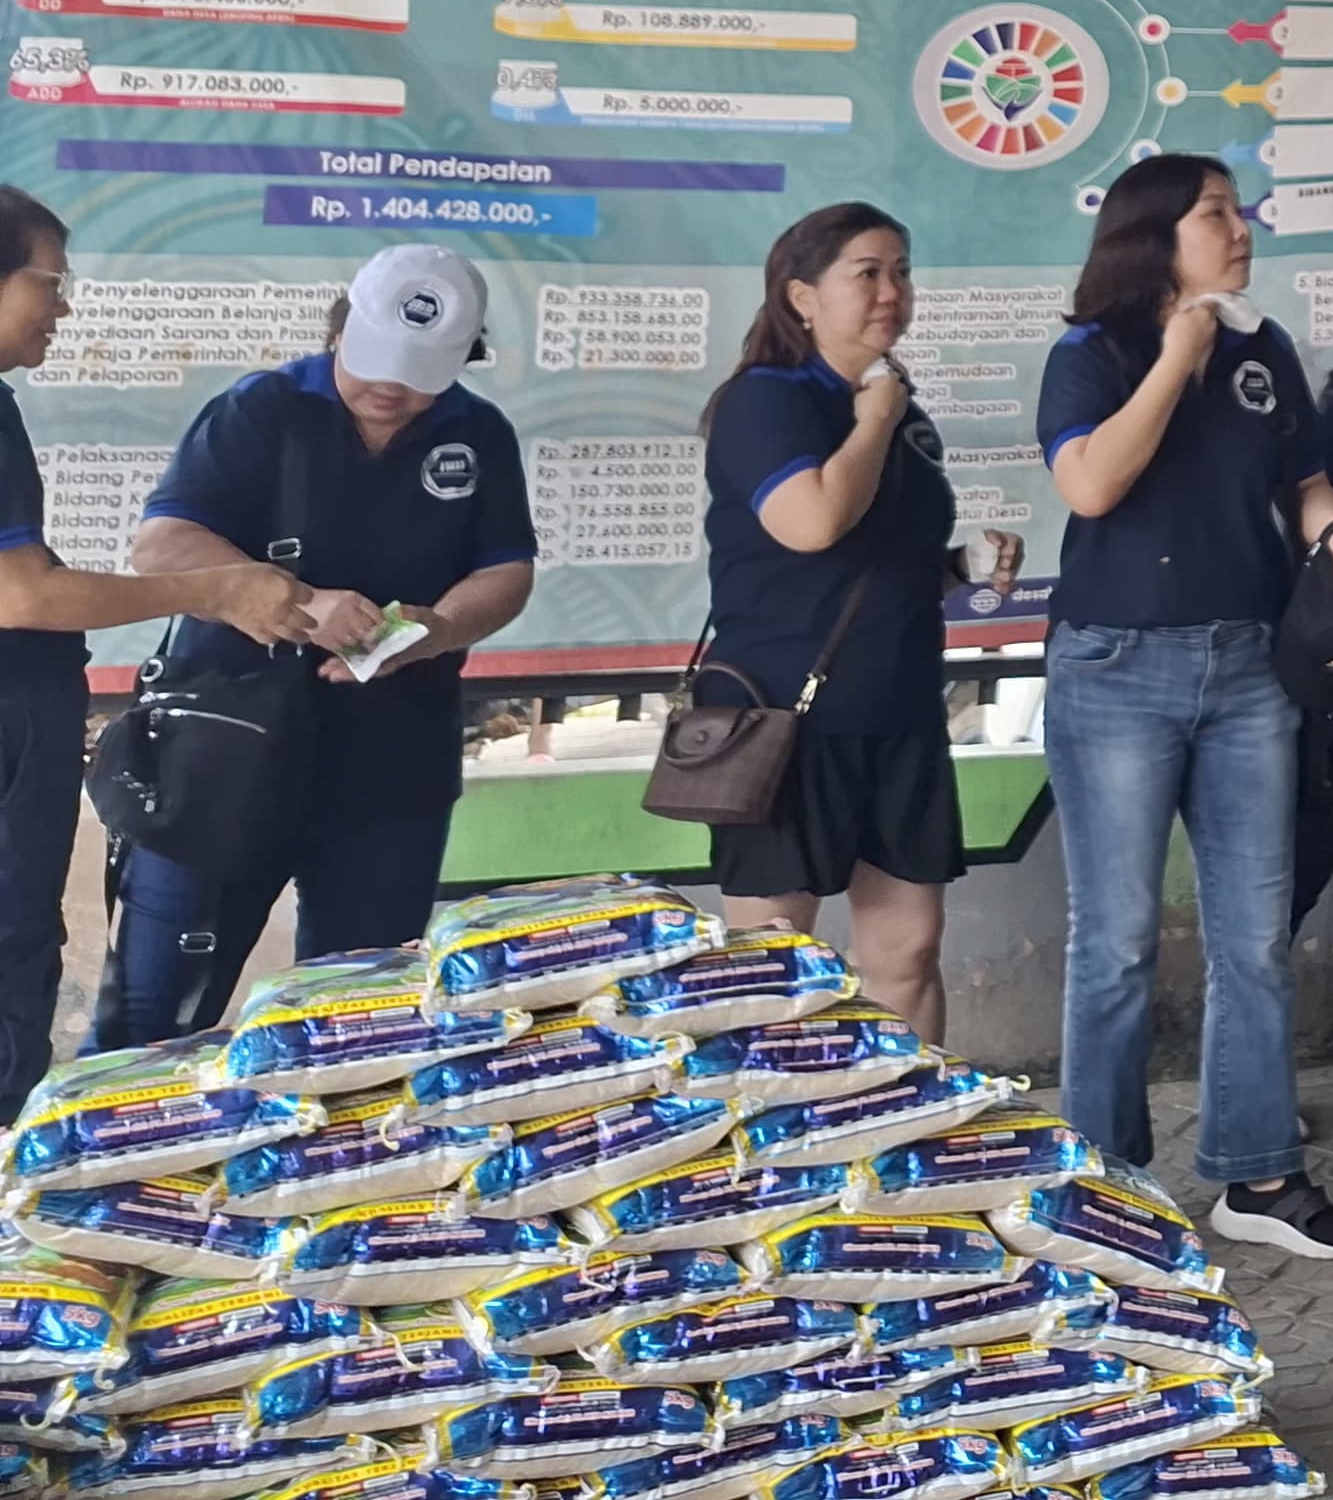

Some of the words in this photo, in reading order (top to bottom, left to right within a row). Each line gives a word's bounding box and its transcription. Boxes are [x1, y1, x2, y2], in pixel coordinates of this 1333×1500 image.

[602, 11, 632, 30] Rp.
[120, 72, 153, 93] Rp.
[603, 94, 632, 114] Rp.
[320, 151, 381, 174] Total
[389, 153, 552, 183] Pendapatan
[311, 196, 352, 221] Rp.
[363, 197, 552, 226] 1.404.428.000,-
[82, 283, 256, 302] Penyelenggaraan
[72, 306, 215, 322] yelenggaraan
[221, 305, 292, 322] Belanja
[917, 310, 1010, 322] etentraman
[50, 326, 155, 343] enyediaan
[162, 326, 231, 341] Sarana
[236, 327, 273, 341] dan
[33, 368, 71, 382] dan
[77, 367, 179, 386] Pelaporan
[914, 364, 1014, 380] epemudaan
[928, 401, 1019, 416] embagaan
[56, 448, 174, 465] Pelaksanaa
[56, 470, 125, 487] Bidang
[54, 492, 122, 509] Bidang
[51, 513, 120, 530] Bidang
[70, 556, 115, 573] dang
